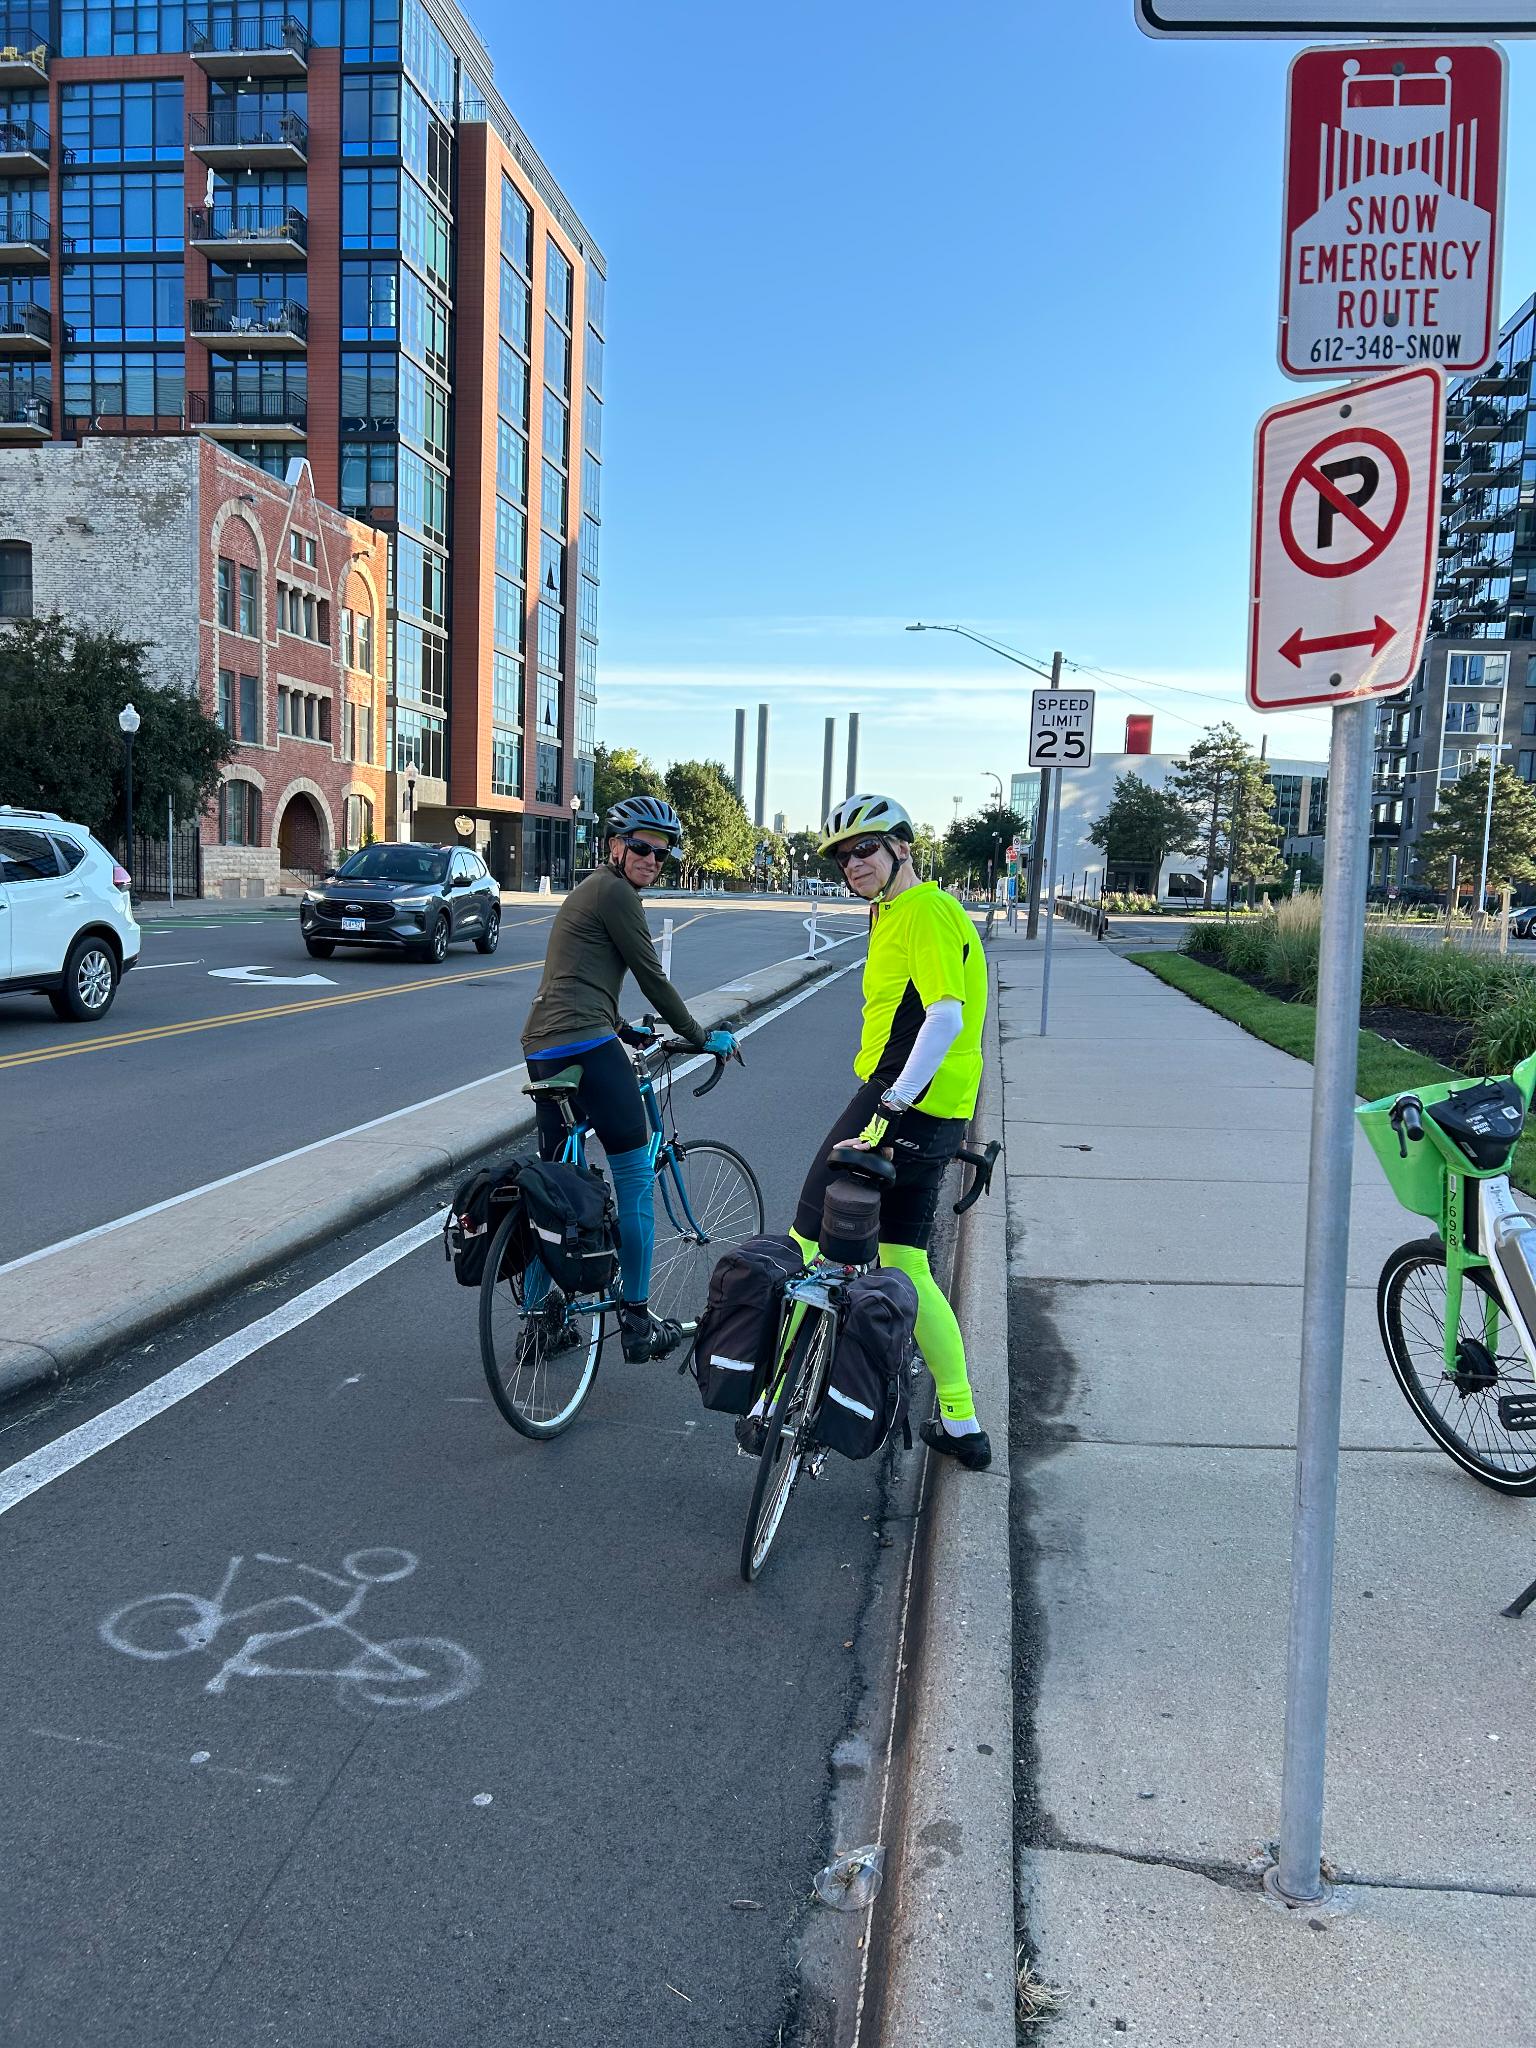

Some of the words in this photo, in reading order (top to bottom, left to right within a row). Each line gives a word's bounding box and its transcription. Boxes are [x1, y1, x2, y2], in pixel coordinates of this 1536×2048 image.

[1346, 194, 1439, 236] SNOW
[1298, 240, 1481, 285] EMERGENCY
[1337, 288, 1440, 330] ROUTE
[1310, 333, 1462, 363] 612-348-SNOW
[1037, 698, 1089, 711] SPEED
[1041, 714, 1083, 727] LIMIT
[1035, 730, 1086, 759] 25
